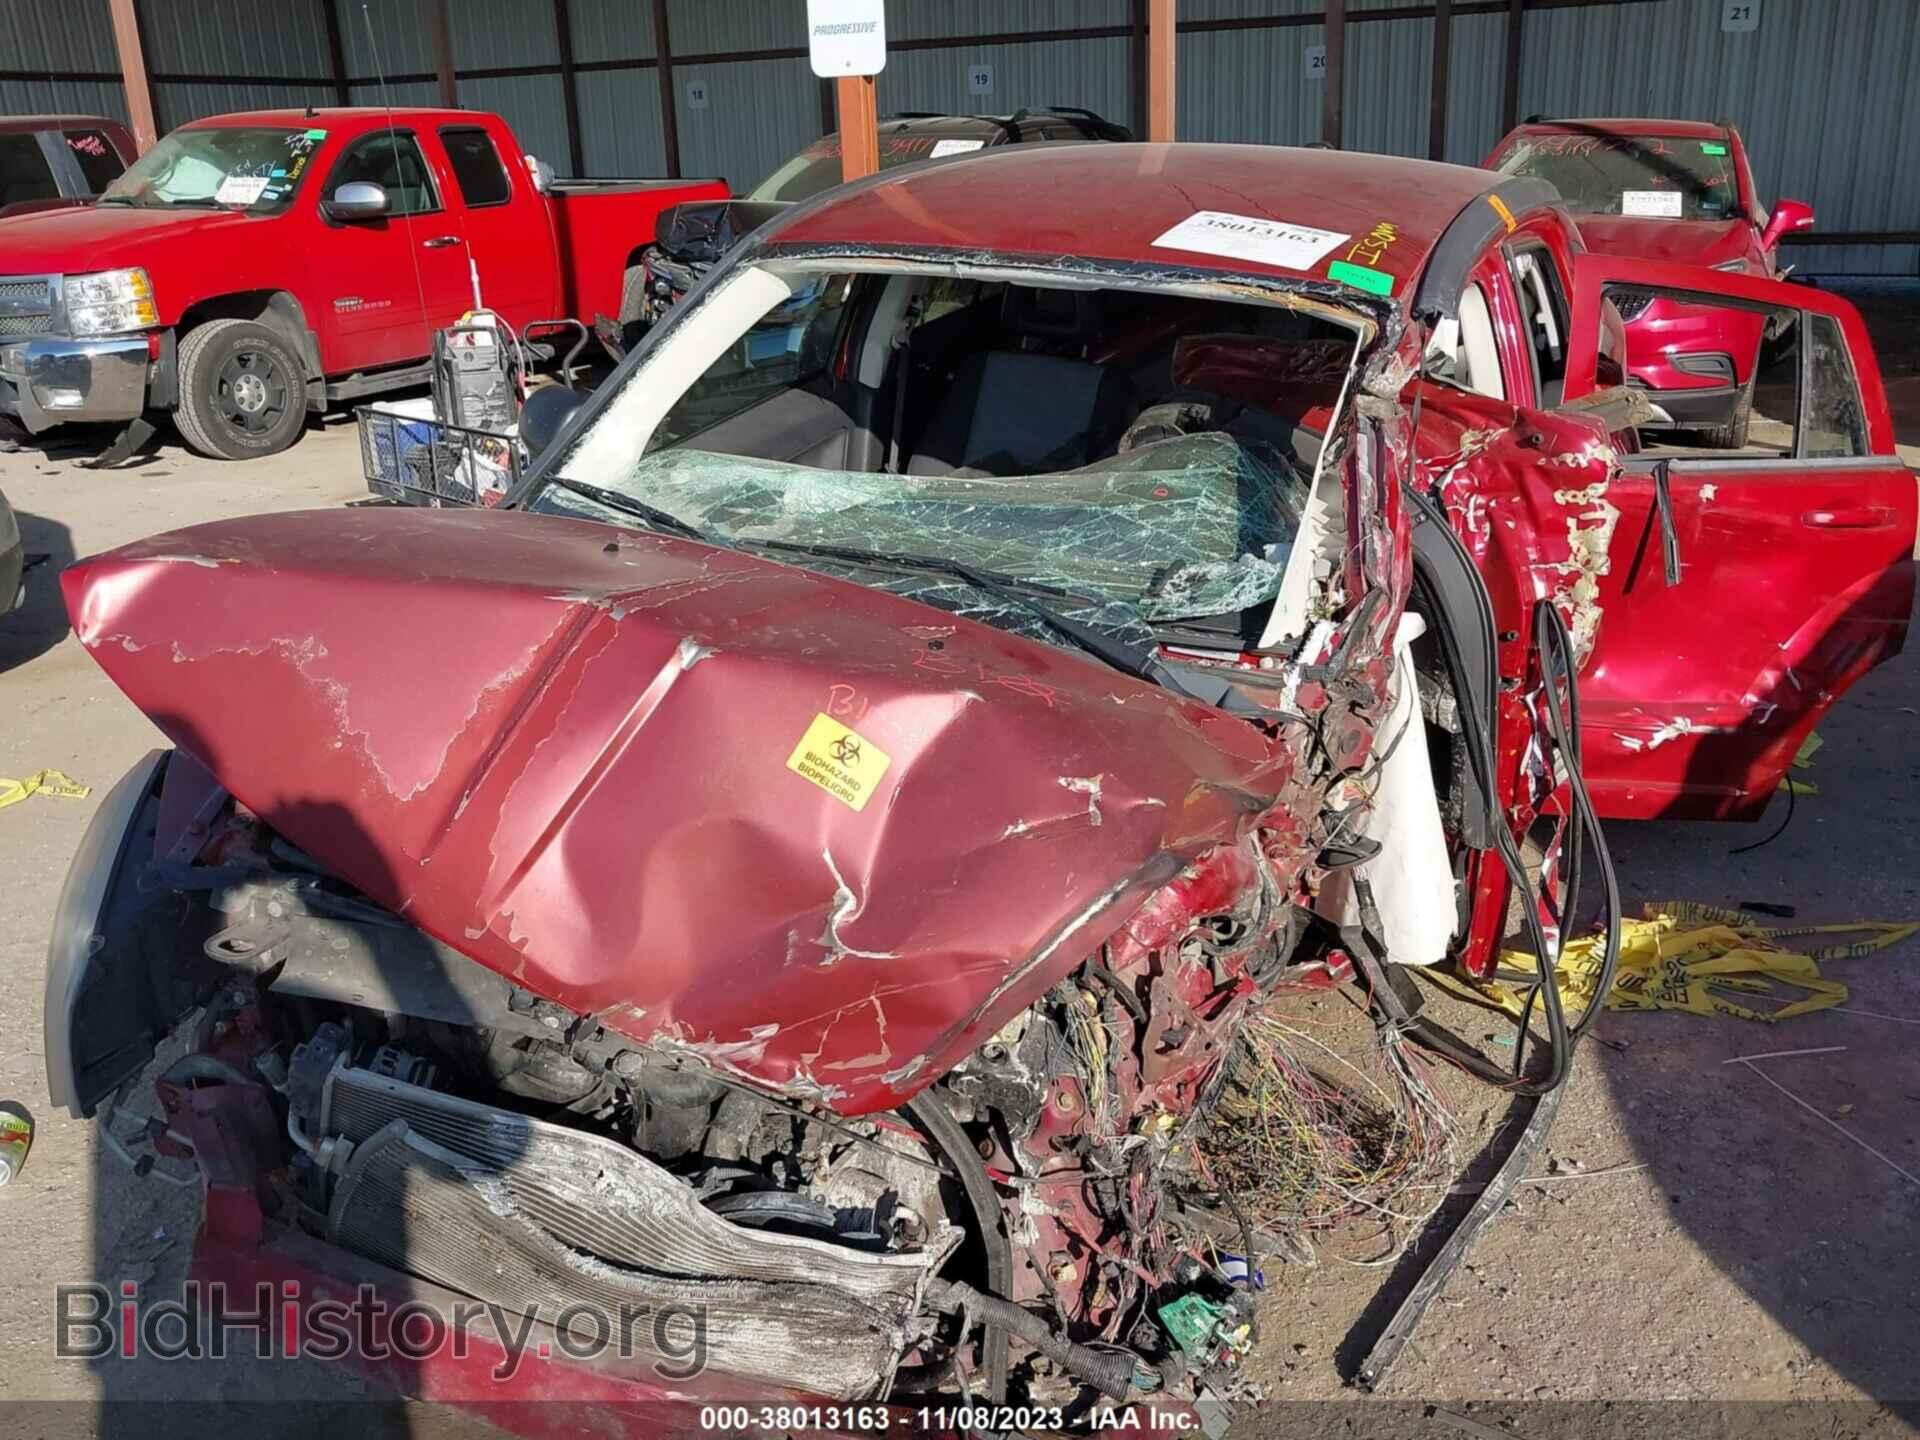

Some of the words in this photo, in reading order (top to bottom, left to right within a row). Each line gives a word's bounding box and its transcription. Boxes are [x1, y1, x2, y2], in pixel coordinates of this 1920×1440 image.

[1730, 6, 1751, 20] 21
[812, 21, 878, 37] PROGRESSIVE
[975, 73, 988, 85] 19
[804, 751, 861, 791] BIOHAZARD
[797, 761, 855, 802] BIOPELIGRO
